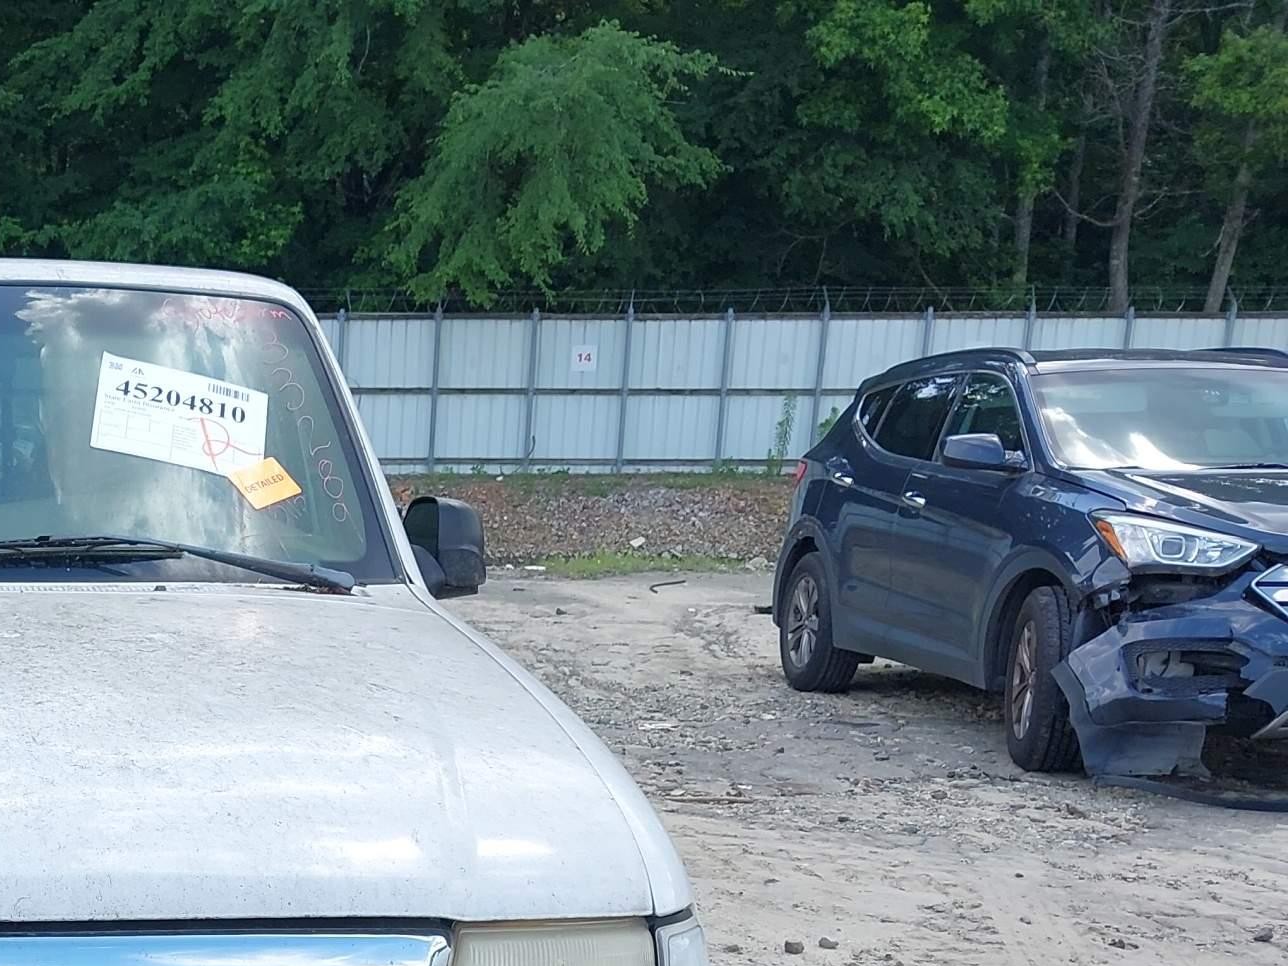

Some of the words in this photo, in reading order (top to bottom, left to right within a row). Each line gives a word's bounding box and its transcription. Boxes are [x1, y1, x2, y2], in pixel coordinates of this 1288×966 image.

[577, 353, 592, 363] 14
[115, 379, 246, 424] 45204810
[244, 473, 285, 494] DETAILED
